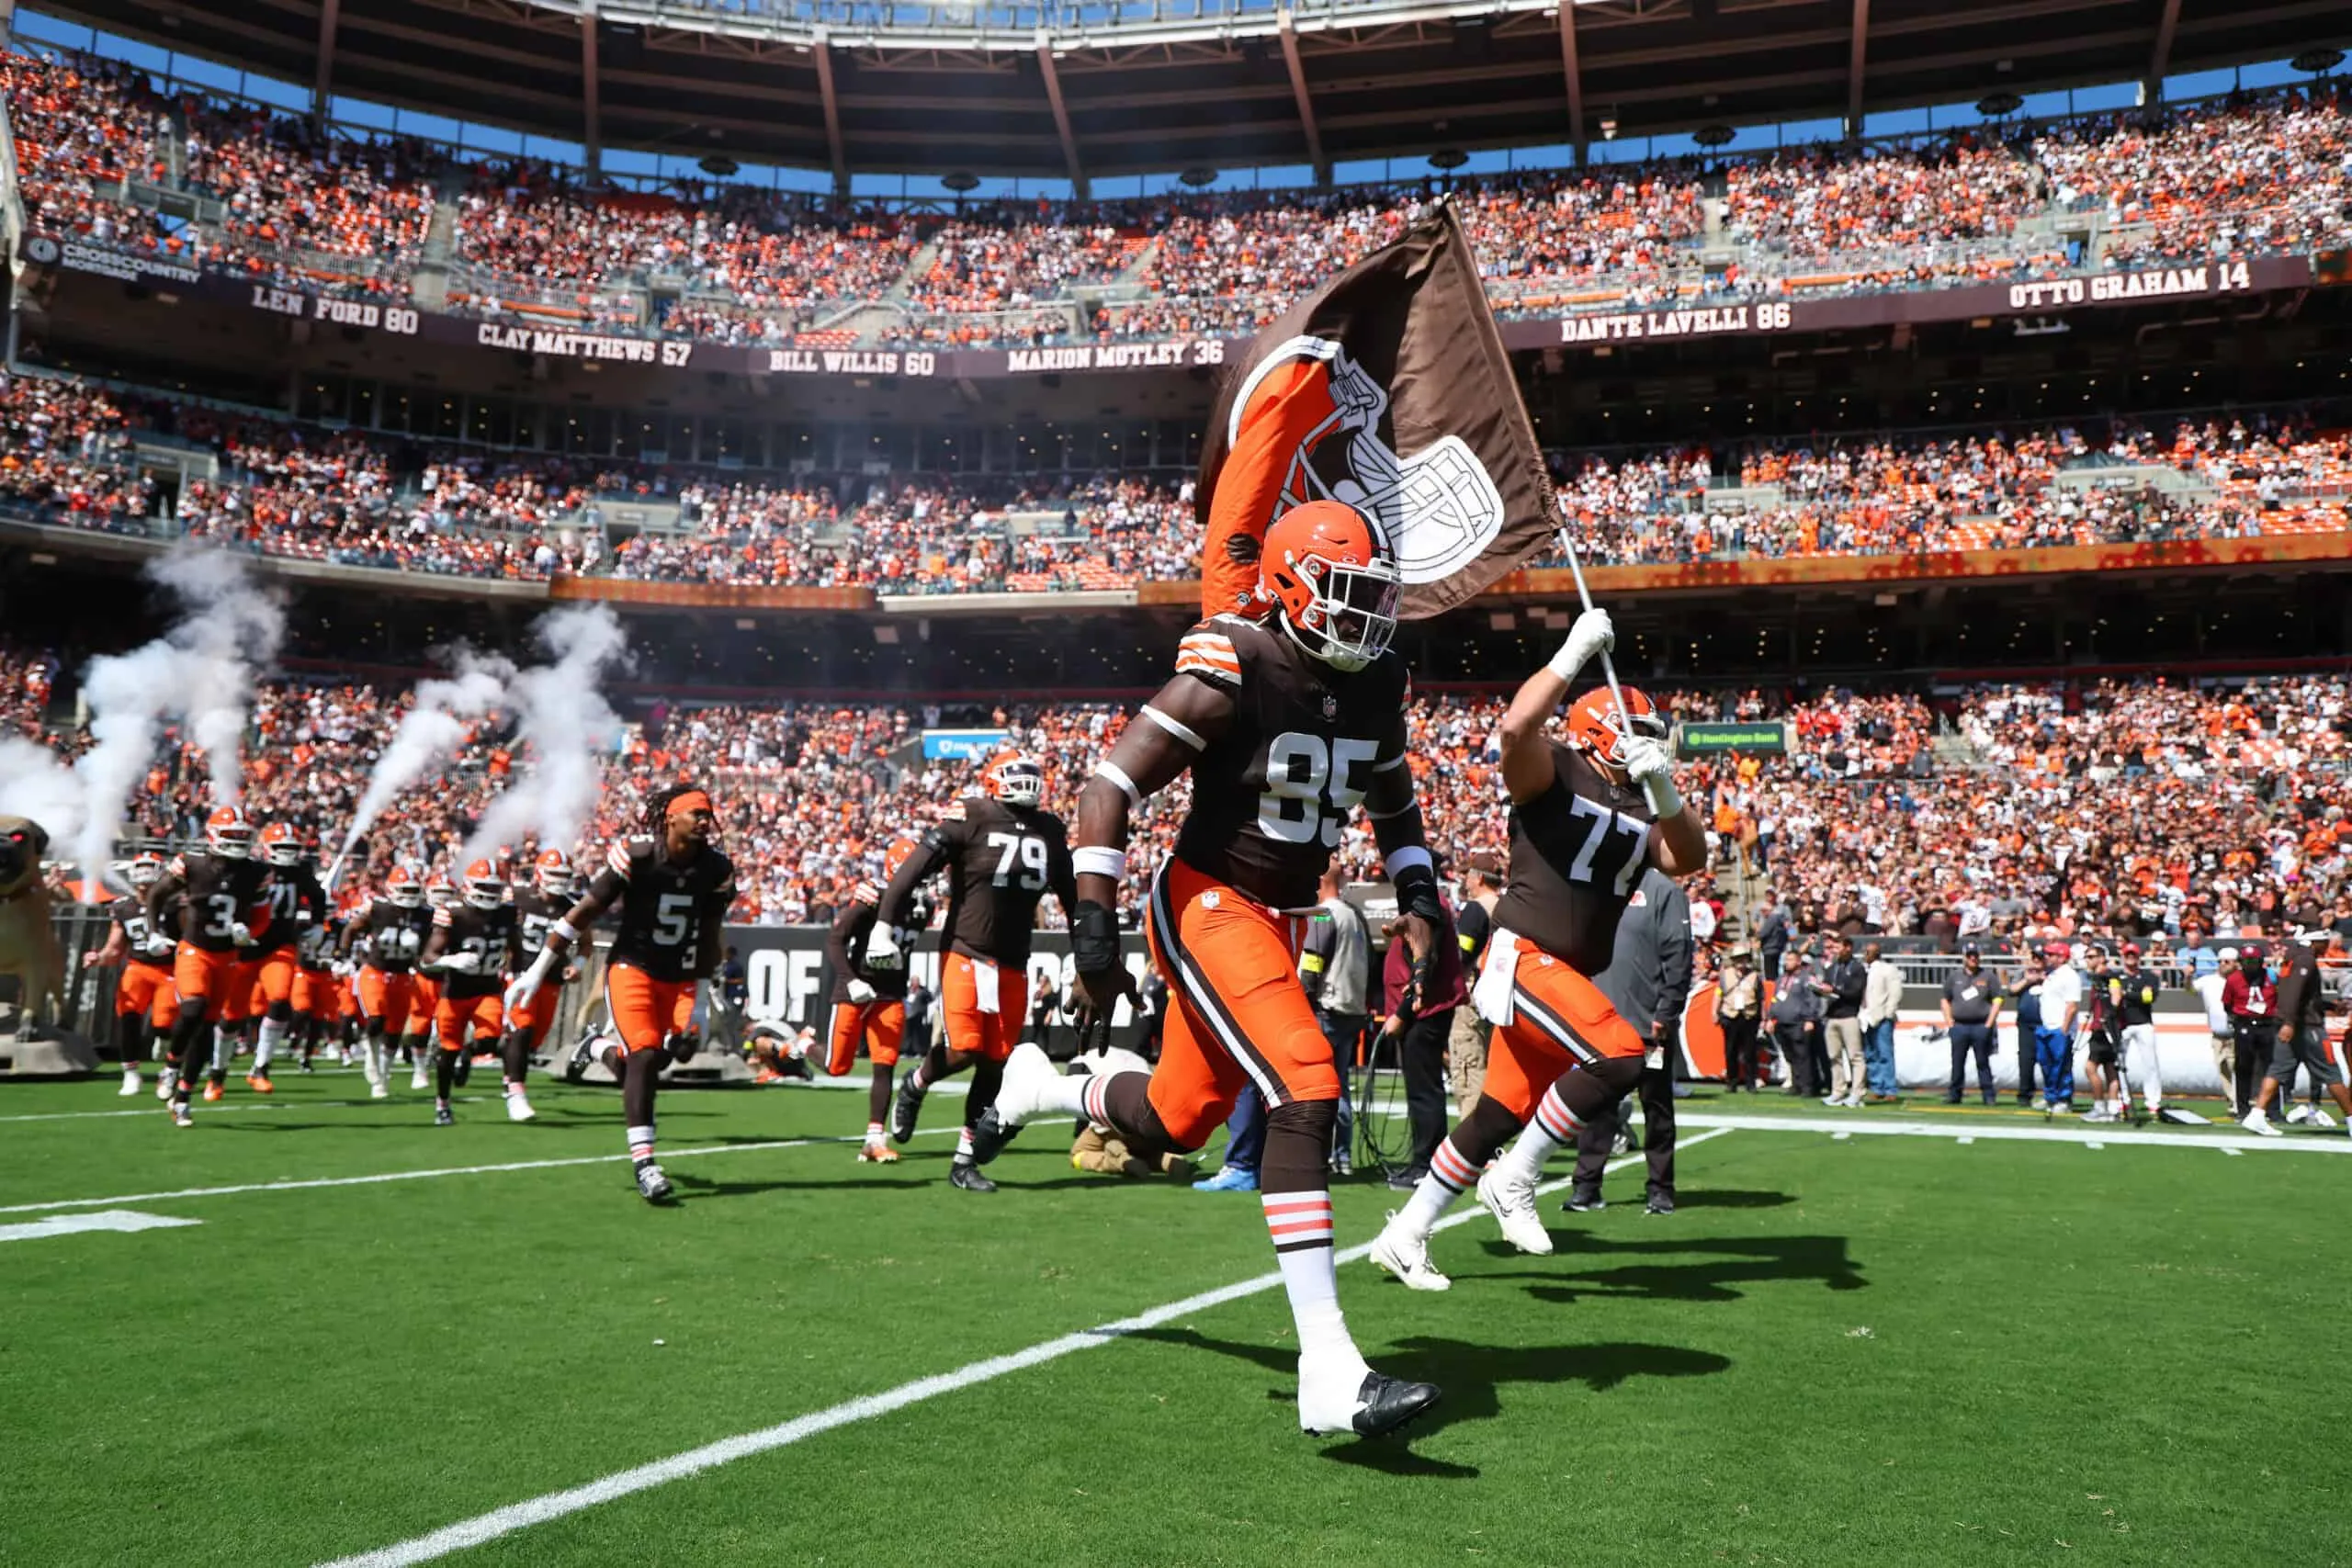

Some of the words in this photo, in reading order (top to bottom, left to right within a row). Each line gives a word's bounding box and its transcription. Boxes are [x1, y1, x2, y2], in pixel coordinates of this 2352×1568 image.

[62, 243, 201, 283] CROSSCOUNTRY
[2009, 281, 2084, 309] OTTO
[2090, 267, 2208, 301] GRAHAM
[2218, 261, 2250, 291] 14
[253, 285, 304, 316] LEN
[315, 299, 379, 327] FORD
[385, 308, 419, 335] 80
[1562, 314, 1643, 343] DANTE
[1647, 307, 1748, 336] LAVELLI
[1756, 302, 1791, 331] 86
[478, 323, 532, 351] CLAY
[533, 332, 656, 363] MATTHEWS
[662, 341, 692, 367] 57
[769, 351, 819, 372] BILL
[822, 352, 898, 374] WILLIS
[904, 352, 935, 376] 60
[1007, 346, 1092, 372] MARION
[1095, 343, 1188, 368] MOTLEY
[1193, 340, 1224, 365] 36
[1258, 731, 1380, 848] 85
[988, 832, 1047, 891] 79
[1569, 793, 1652, 897] 77
[204, 893, 237, 937] 3
[747, 949, 822, 1022] OF
